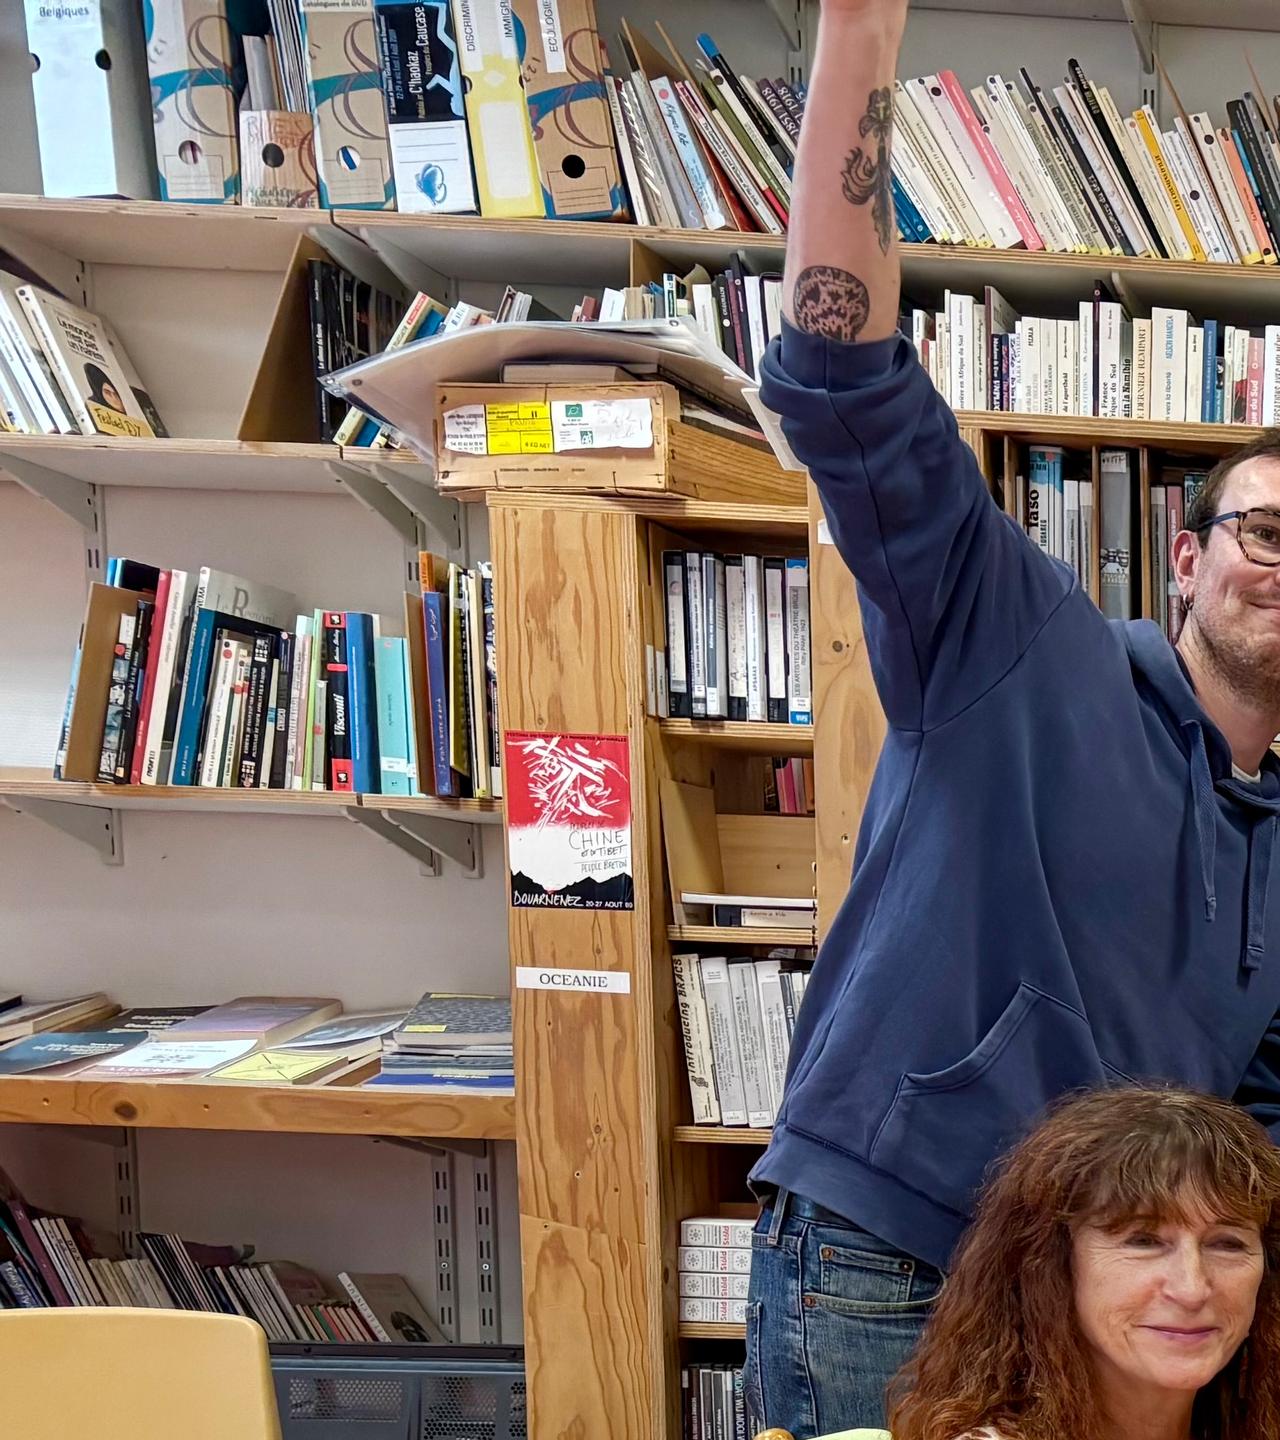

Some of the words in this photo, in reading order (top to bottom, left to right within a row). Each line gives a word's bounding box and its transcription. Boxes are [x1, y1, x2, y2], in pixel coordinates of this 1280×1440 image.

[412, 5, 429, 46] Caucase
[405, 50, 422, 93] C'haokaz
[333, 693, 346, 737] Visconti
[568, 829, 625, 850] CHINE
[514, 890, 585, 908] DOUARNENEZ
[539, 973, 608, 989] OCEANIE
